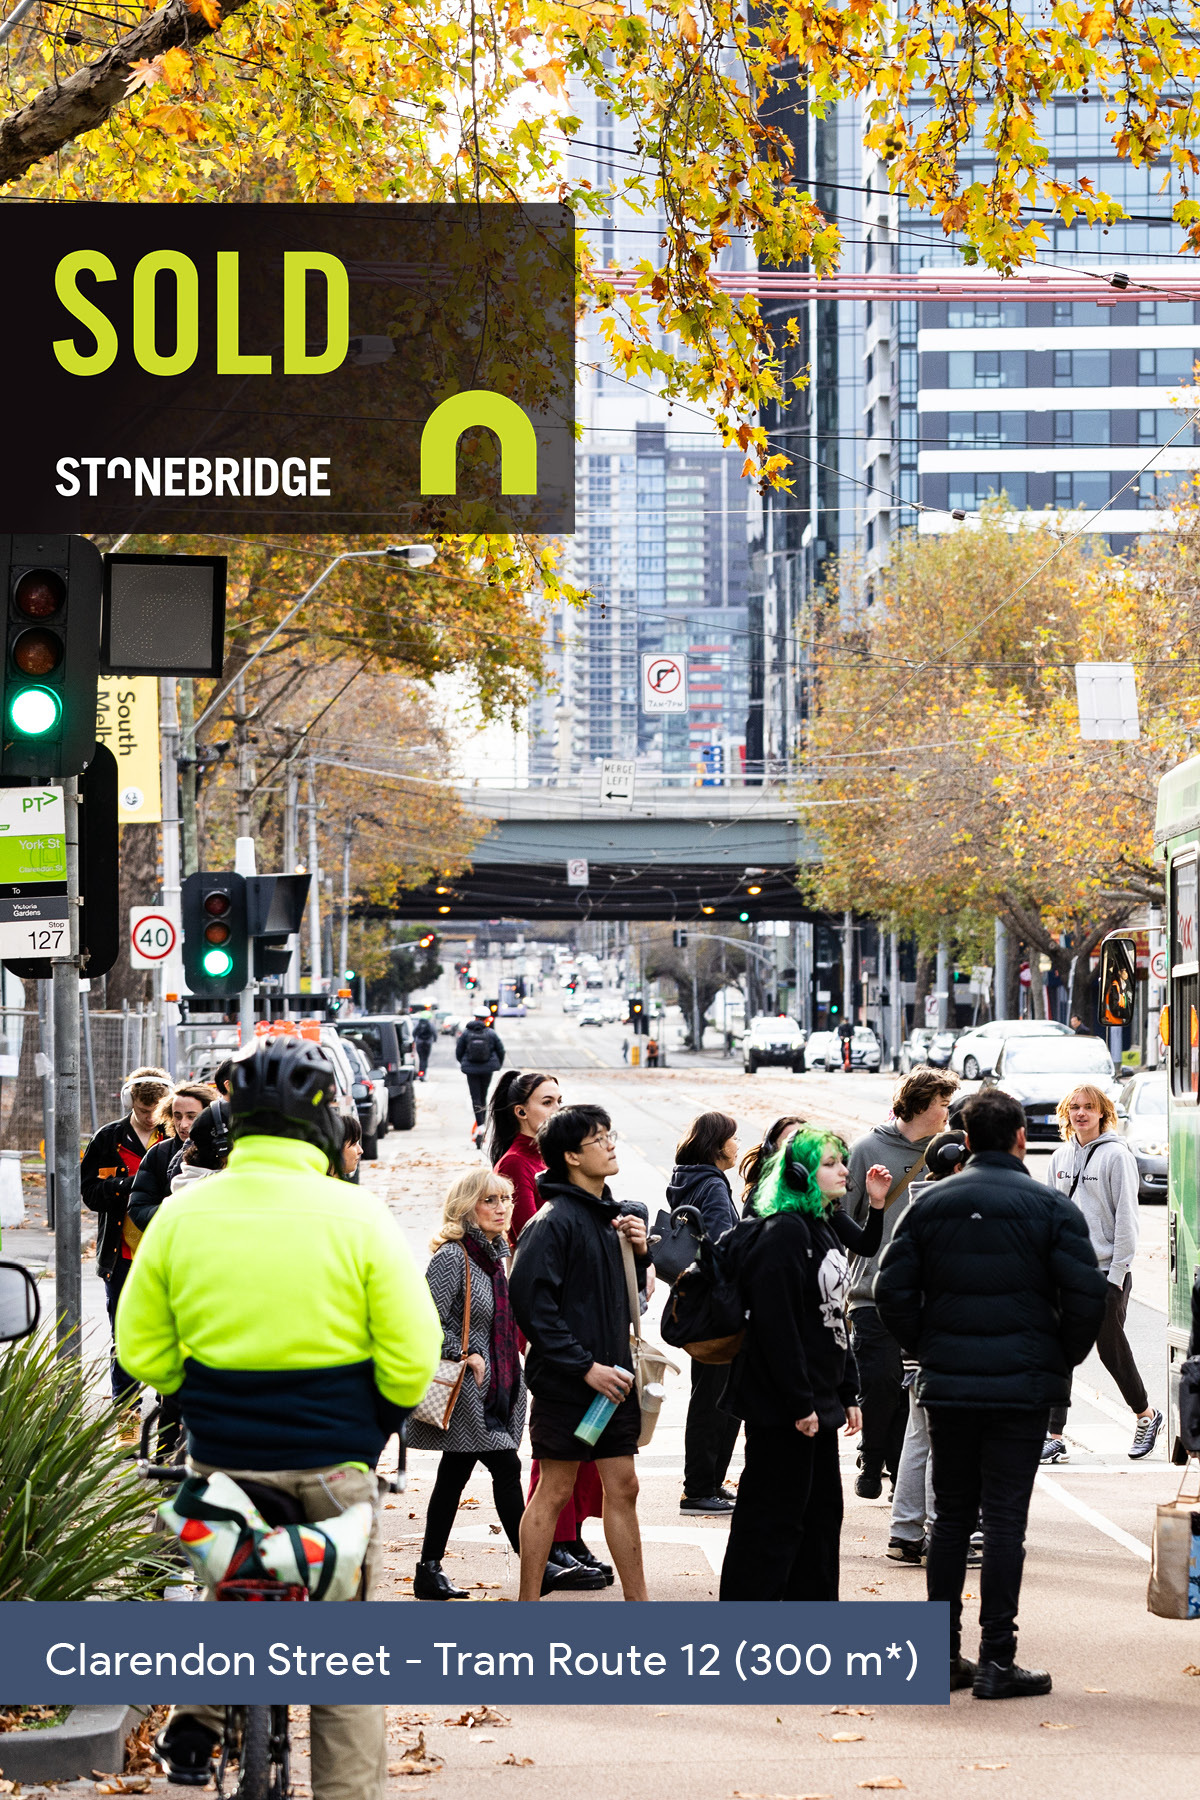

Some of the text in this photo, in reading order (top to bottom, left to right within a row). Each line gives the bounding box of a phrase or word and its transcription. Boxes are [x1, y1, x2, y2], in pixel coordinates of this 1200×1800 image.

[117, 691, 137, 756] South
[604, 764, 633, 774] MERGE
[606, 776, 629, 786] LEFT
[19, 837, 61, 851] York St
[19, 864, 63, 874] Clarendon St
[12, 887, 21, 895] To
[13, 909, 41, 917] Gardens
[48, 921, 65, 929] Stop
[28, 930, 64, 950] 127
[140, 928, 168, 947] 40
[1057, 1170, 1098, 1183] Chpion
